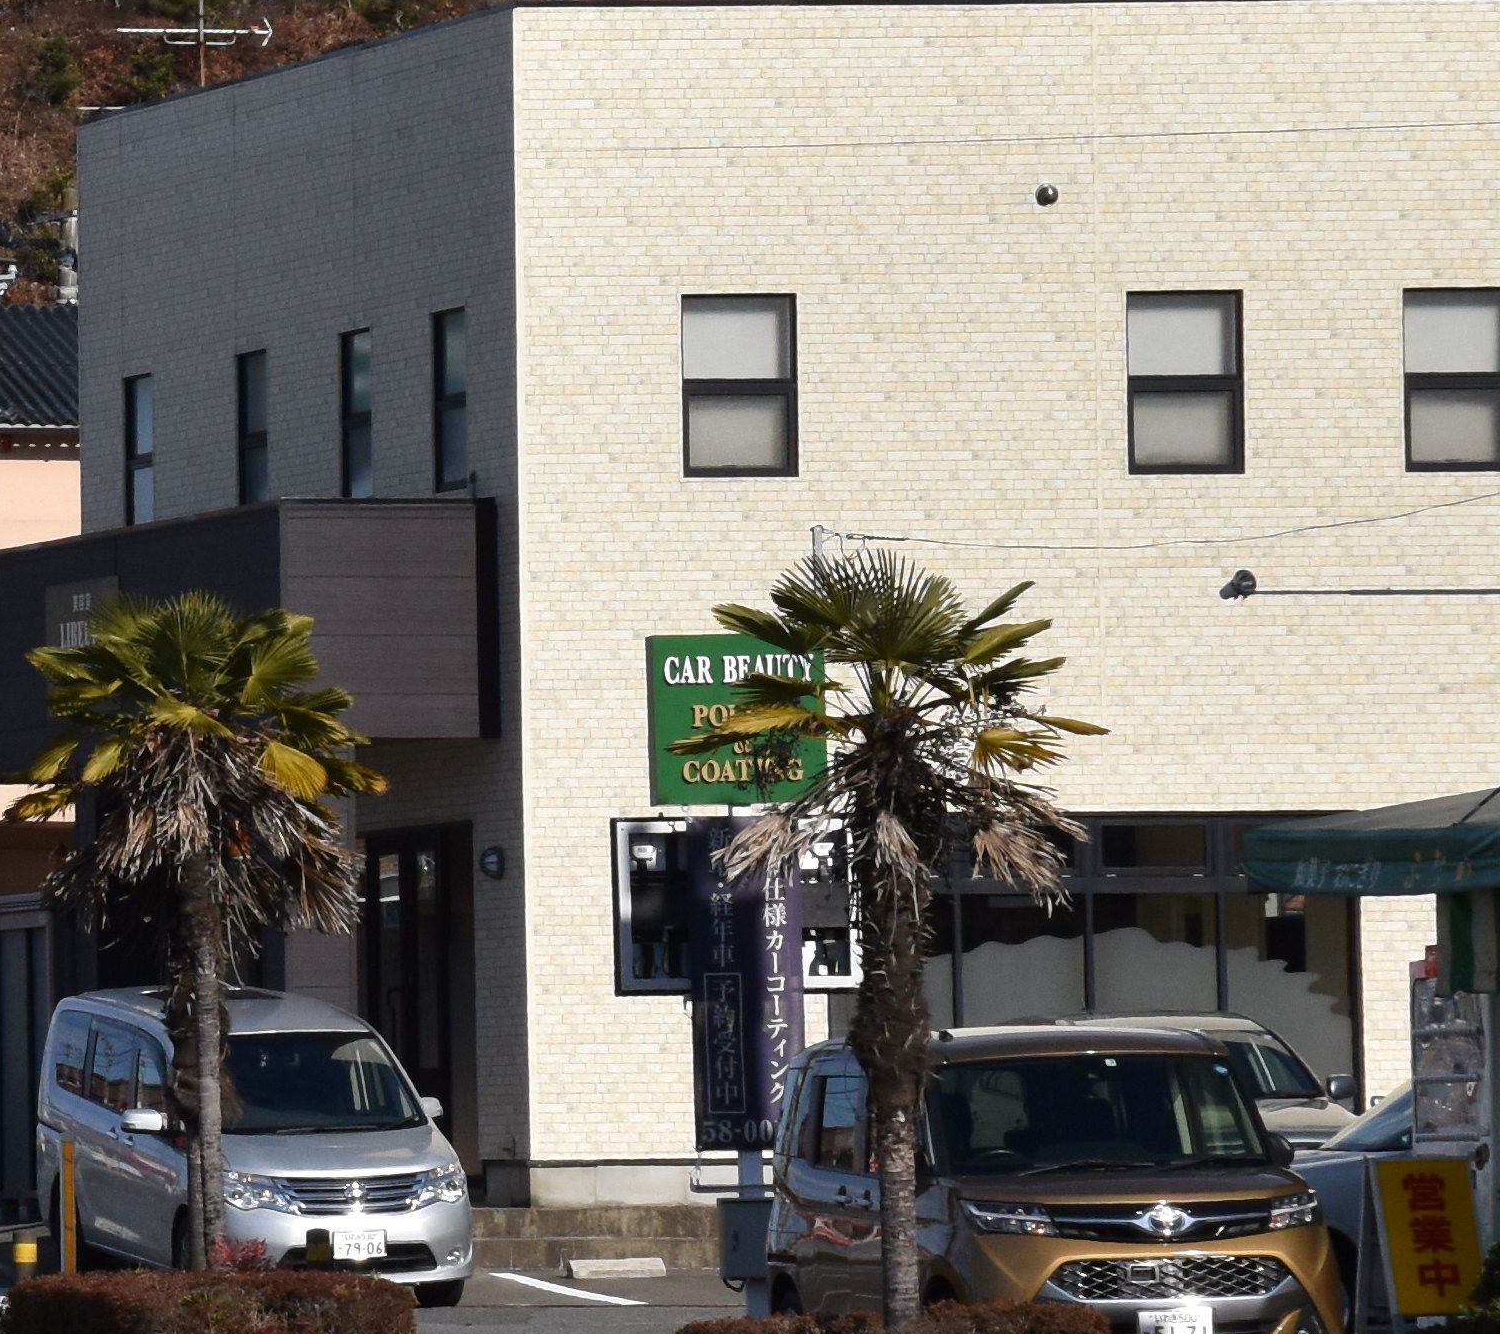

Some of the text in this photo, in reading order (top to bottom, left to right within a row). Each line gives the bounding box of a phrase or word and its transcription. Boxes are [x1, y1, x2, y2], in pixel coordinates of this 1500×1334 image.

[664, 654, 814, 684] CAR BEAUTY
[1402, 1172, 1461, 1298] 営業中
